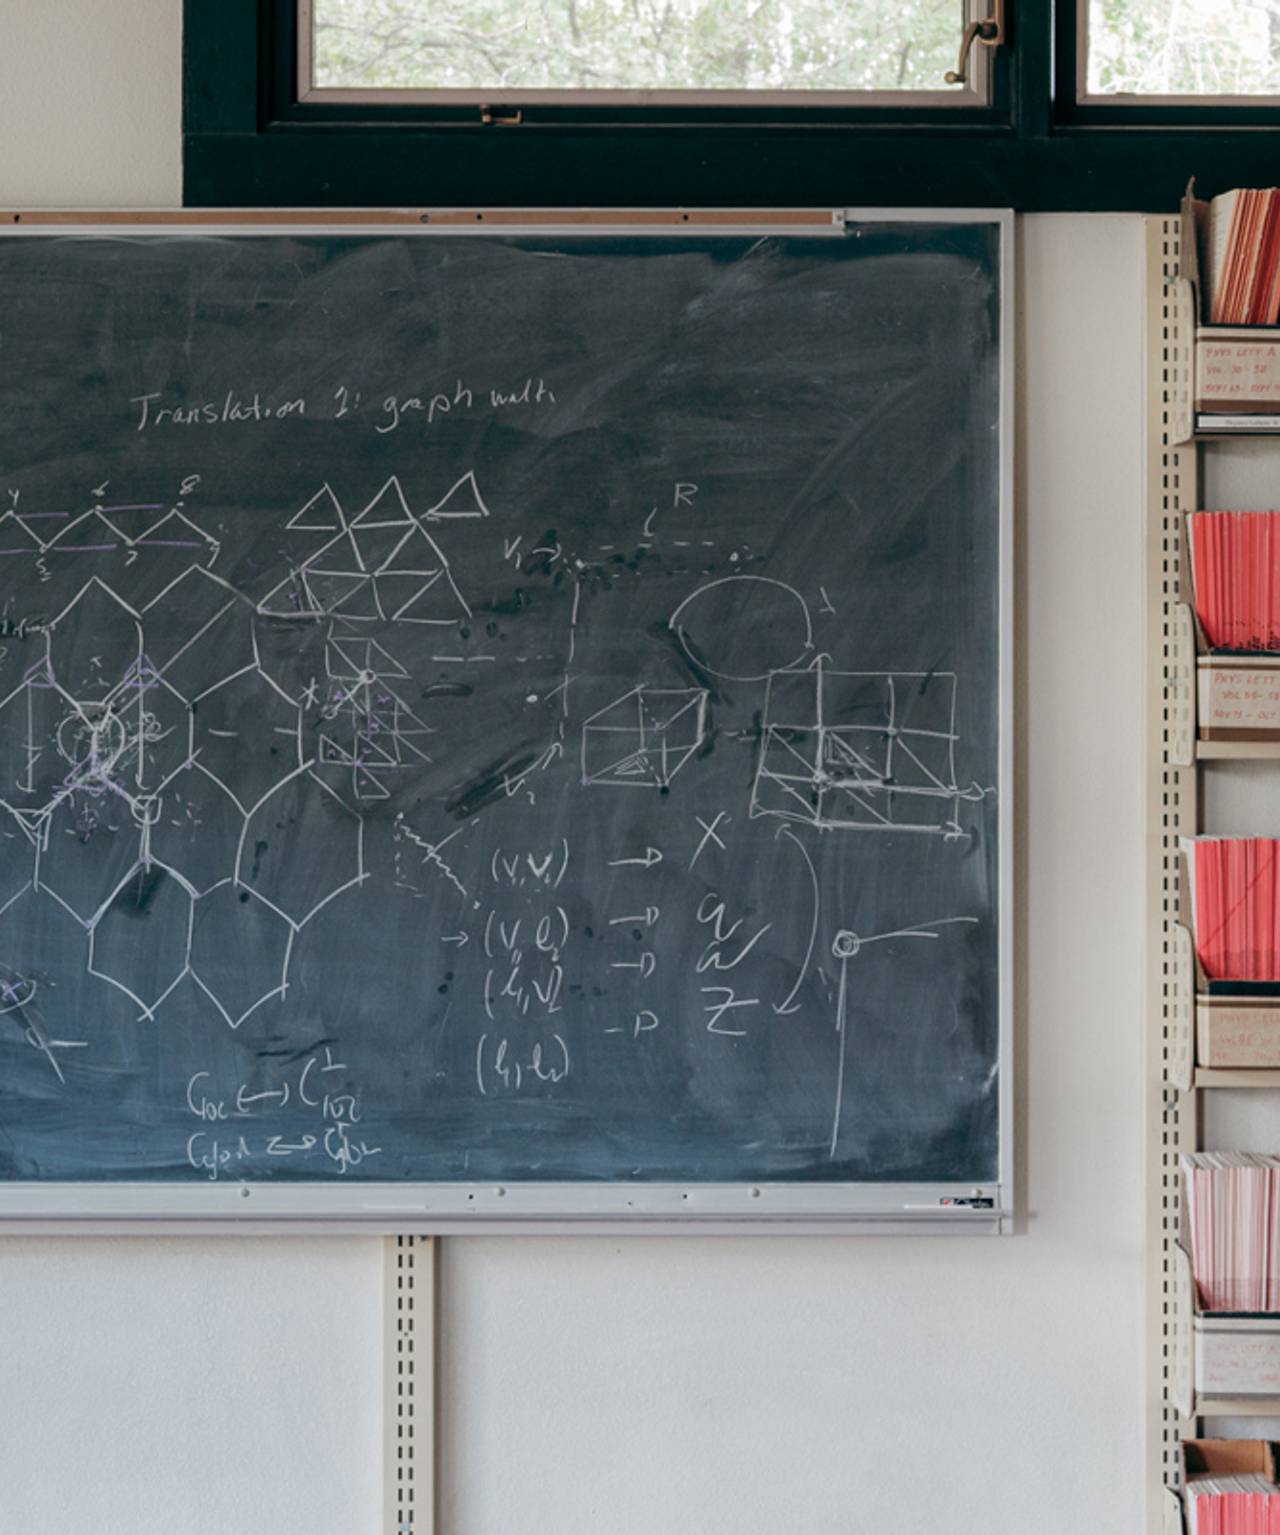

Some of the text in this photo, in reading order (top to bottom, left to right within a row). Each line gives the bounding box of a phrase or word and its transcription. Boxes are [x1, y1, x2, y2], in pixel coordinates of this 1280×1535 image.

[130, 391, 306, 431] Translation
[375, 380, 473, 433] graph
[179, 474, 201, 496] 8
[674, 483, 699, 508] R
